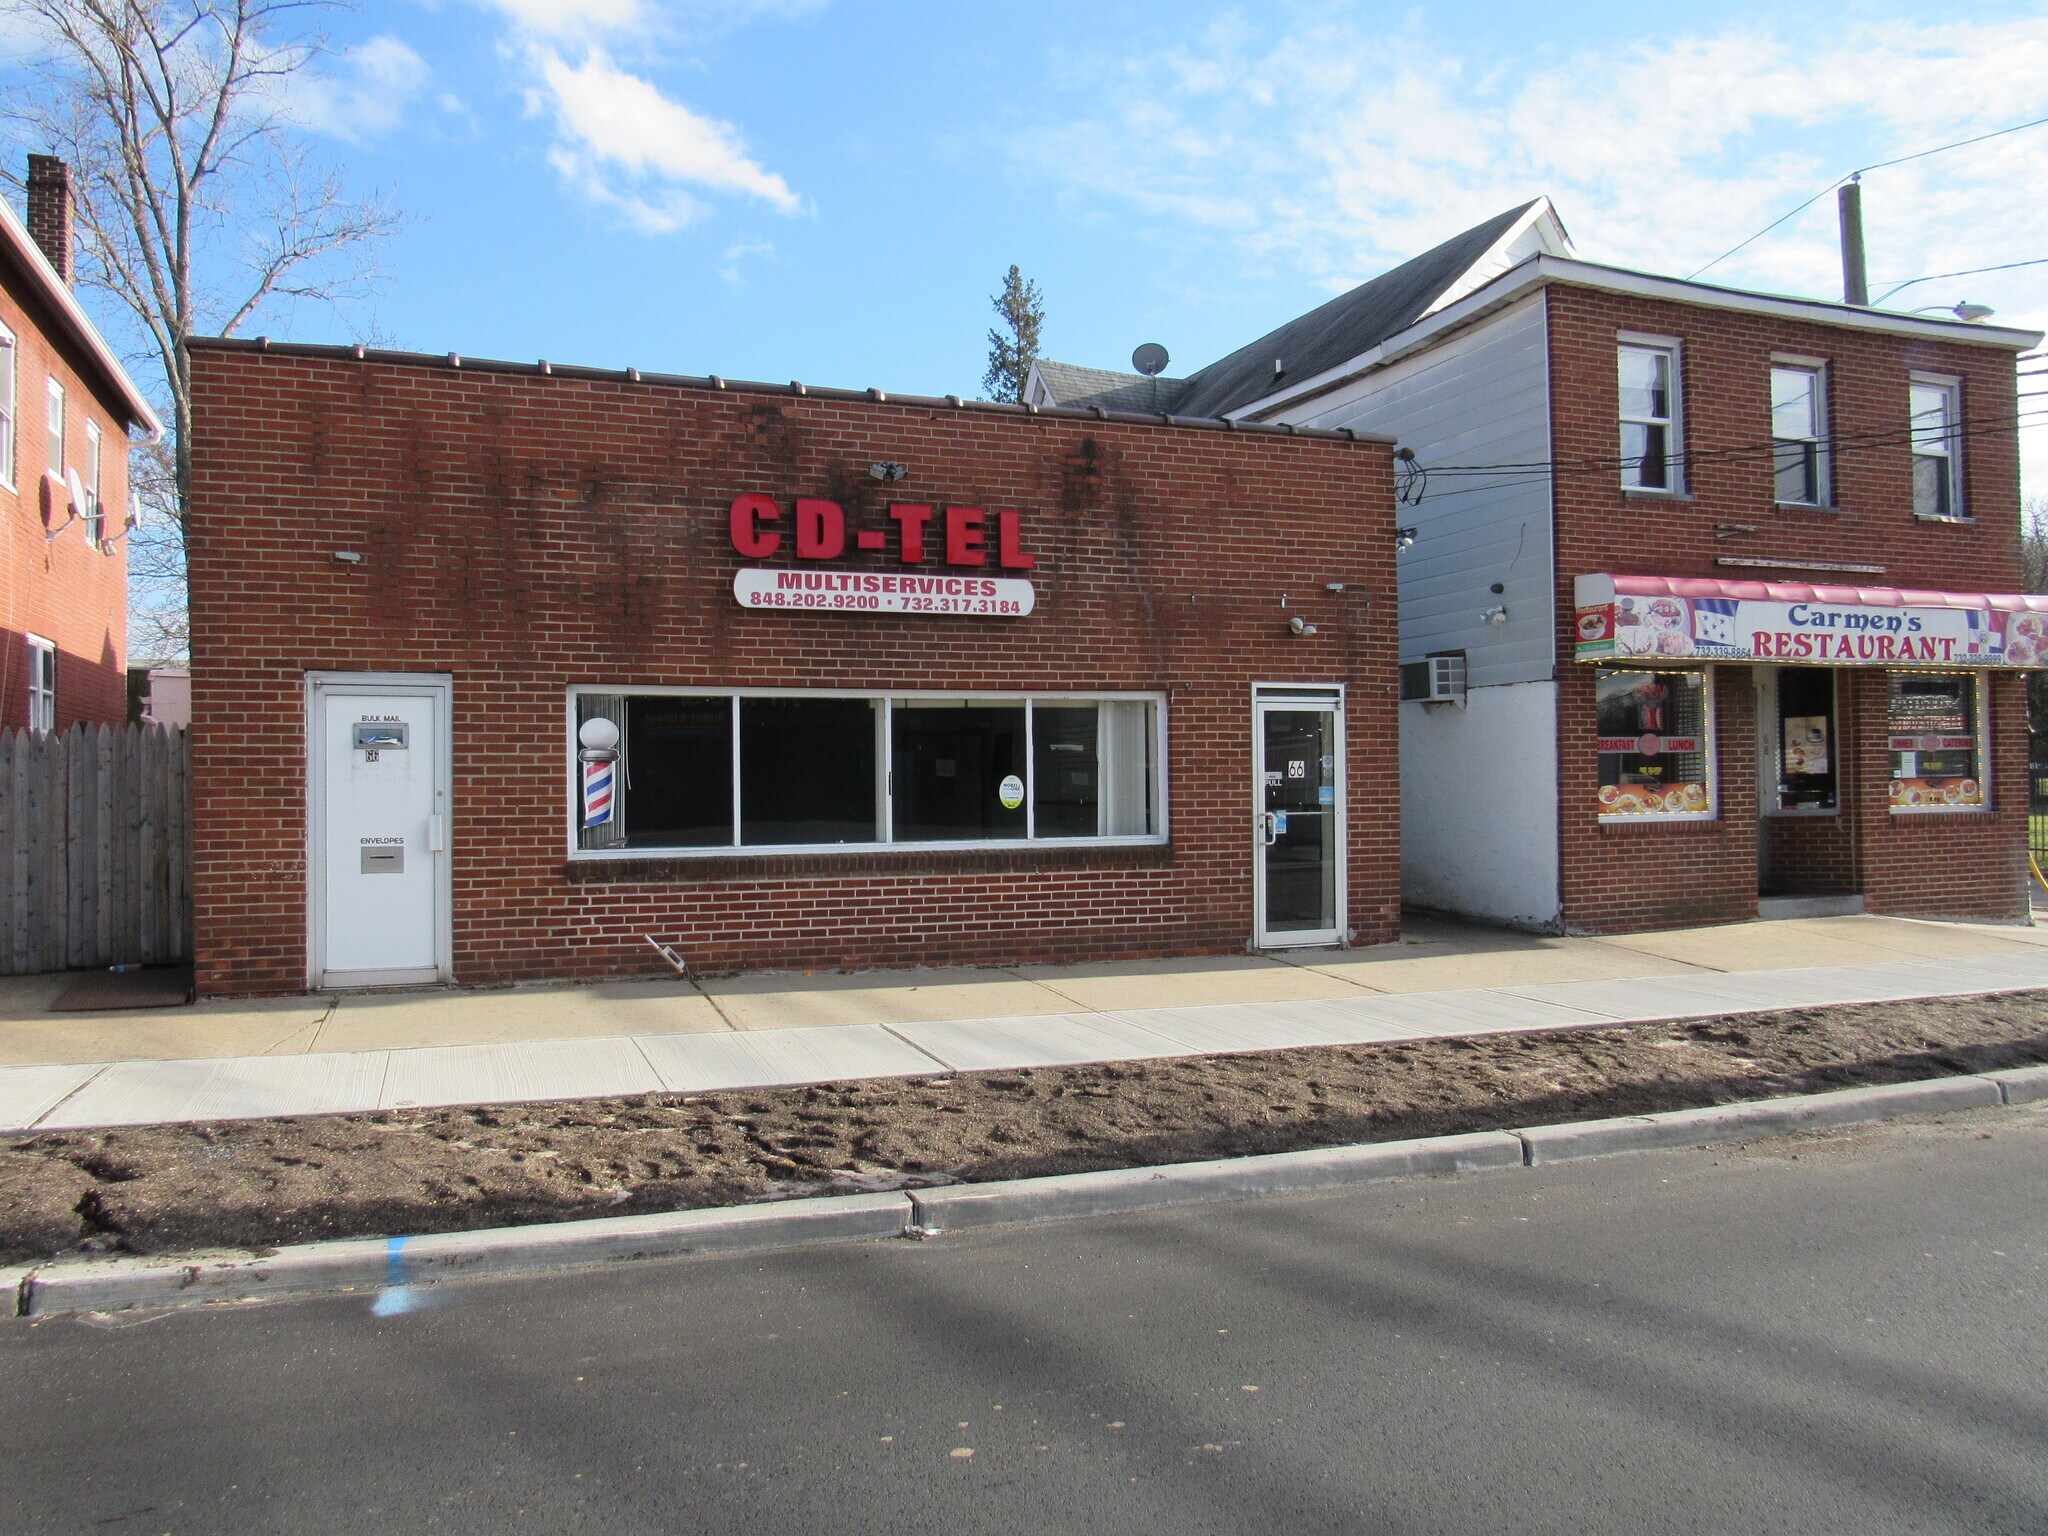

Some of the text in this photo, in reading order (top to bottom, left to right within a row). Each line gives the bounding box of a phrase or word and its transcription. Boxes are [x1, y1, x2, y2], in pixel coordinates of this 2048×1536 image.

[730, 493, 1036, 568] CD-TEL
[777, 572, 997, 597] MULTISERVICES
[750, 591, 1020, 613] 848.202.9200 732.317.3184
[1788, 604, 1921, 634] Carmen's
[1695, 646, 1751, 658] 732-339-8864
[1751, 631, 1956, 660] RESTAURANT
[1597, 739, 1635, 751] BREAKFAST
[1668, 739, 1695, 751] LUNCH
[1289, 761, 1304, 777] 66
[1265, 779, 1283, 787] PULL
